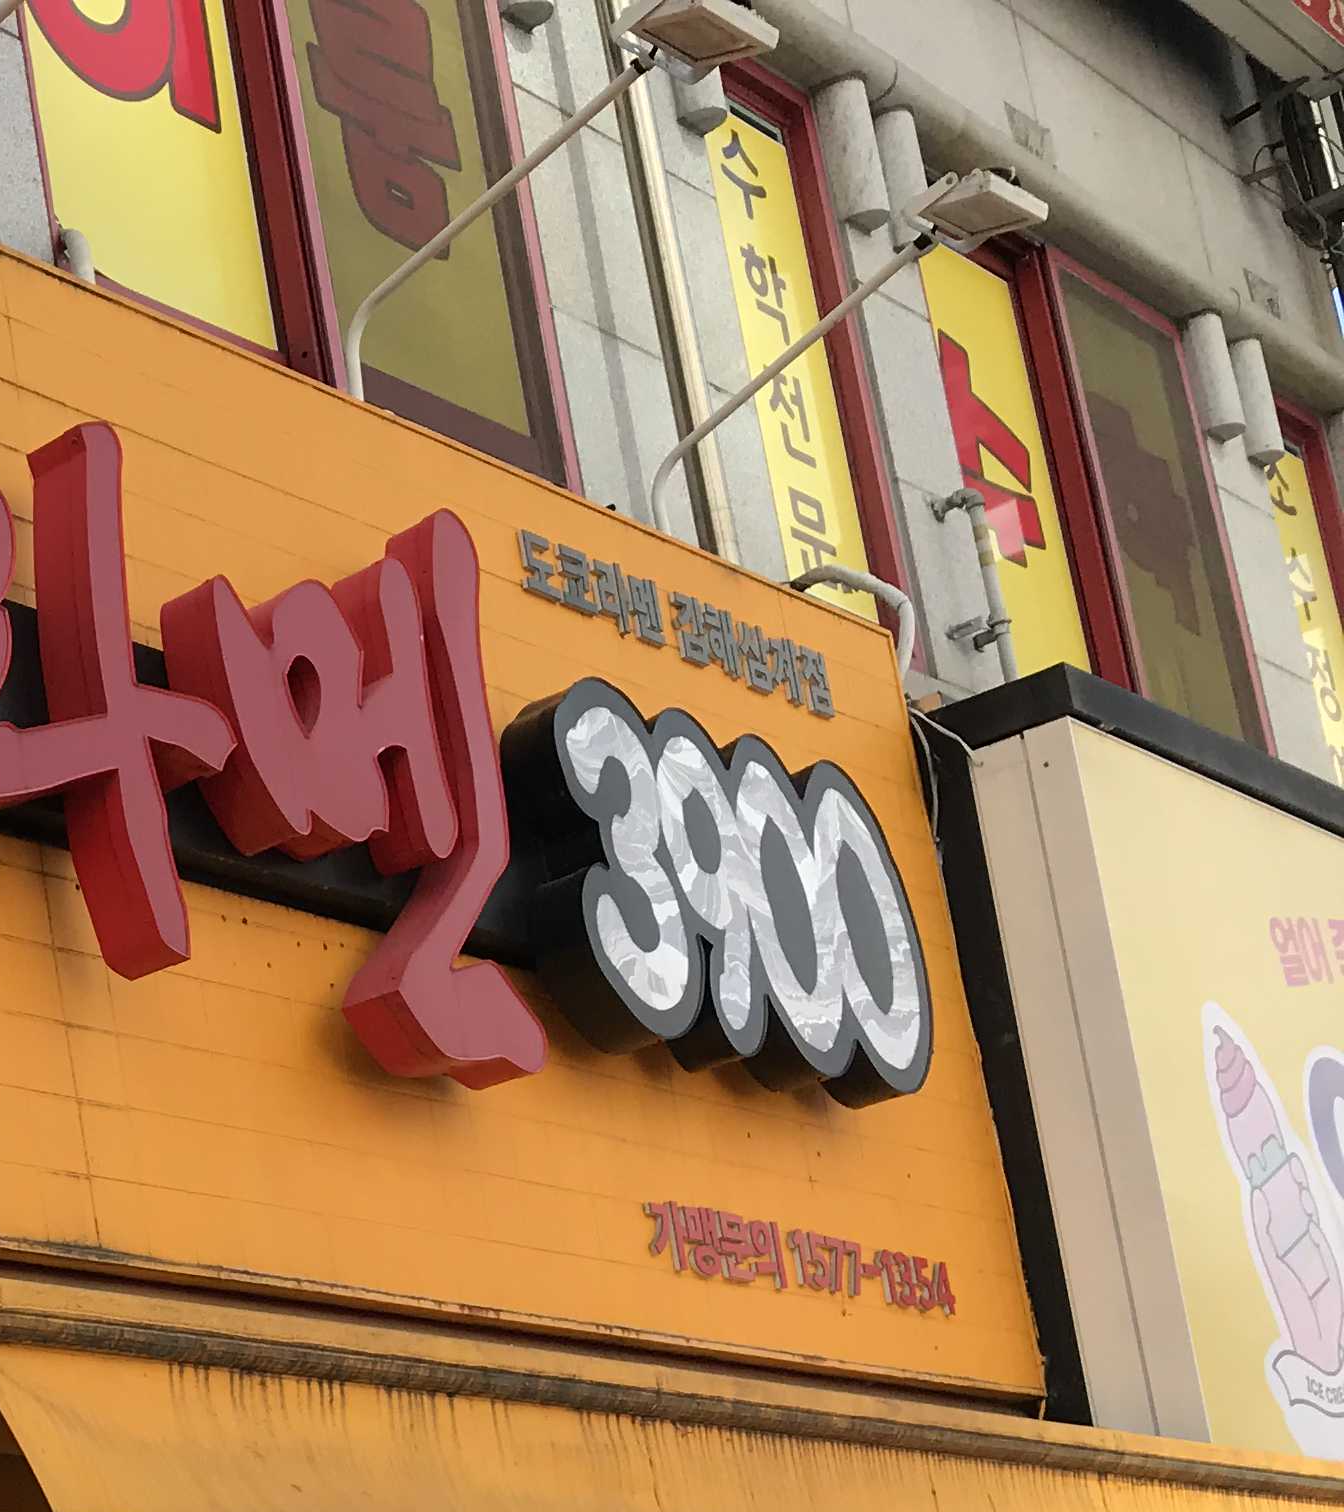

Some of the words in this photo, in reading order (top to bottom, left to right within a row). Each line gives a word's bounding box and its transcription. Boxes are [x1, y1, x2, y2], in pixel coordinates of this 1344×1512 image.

[517, 528, 666, 648] 도쿄라멘
[669, 591, 836, 720] 김해삼계점
[527, 678, 934, 1108] 3900
[643, 1200, 789, 1292] 가맹문의
[787, 1228, 957, 1319] 1577-1354
